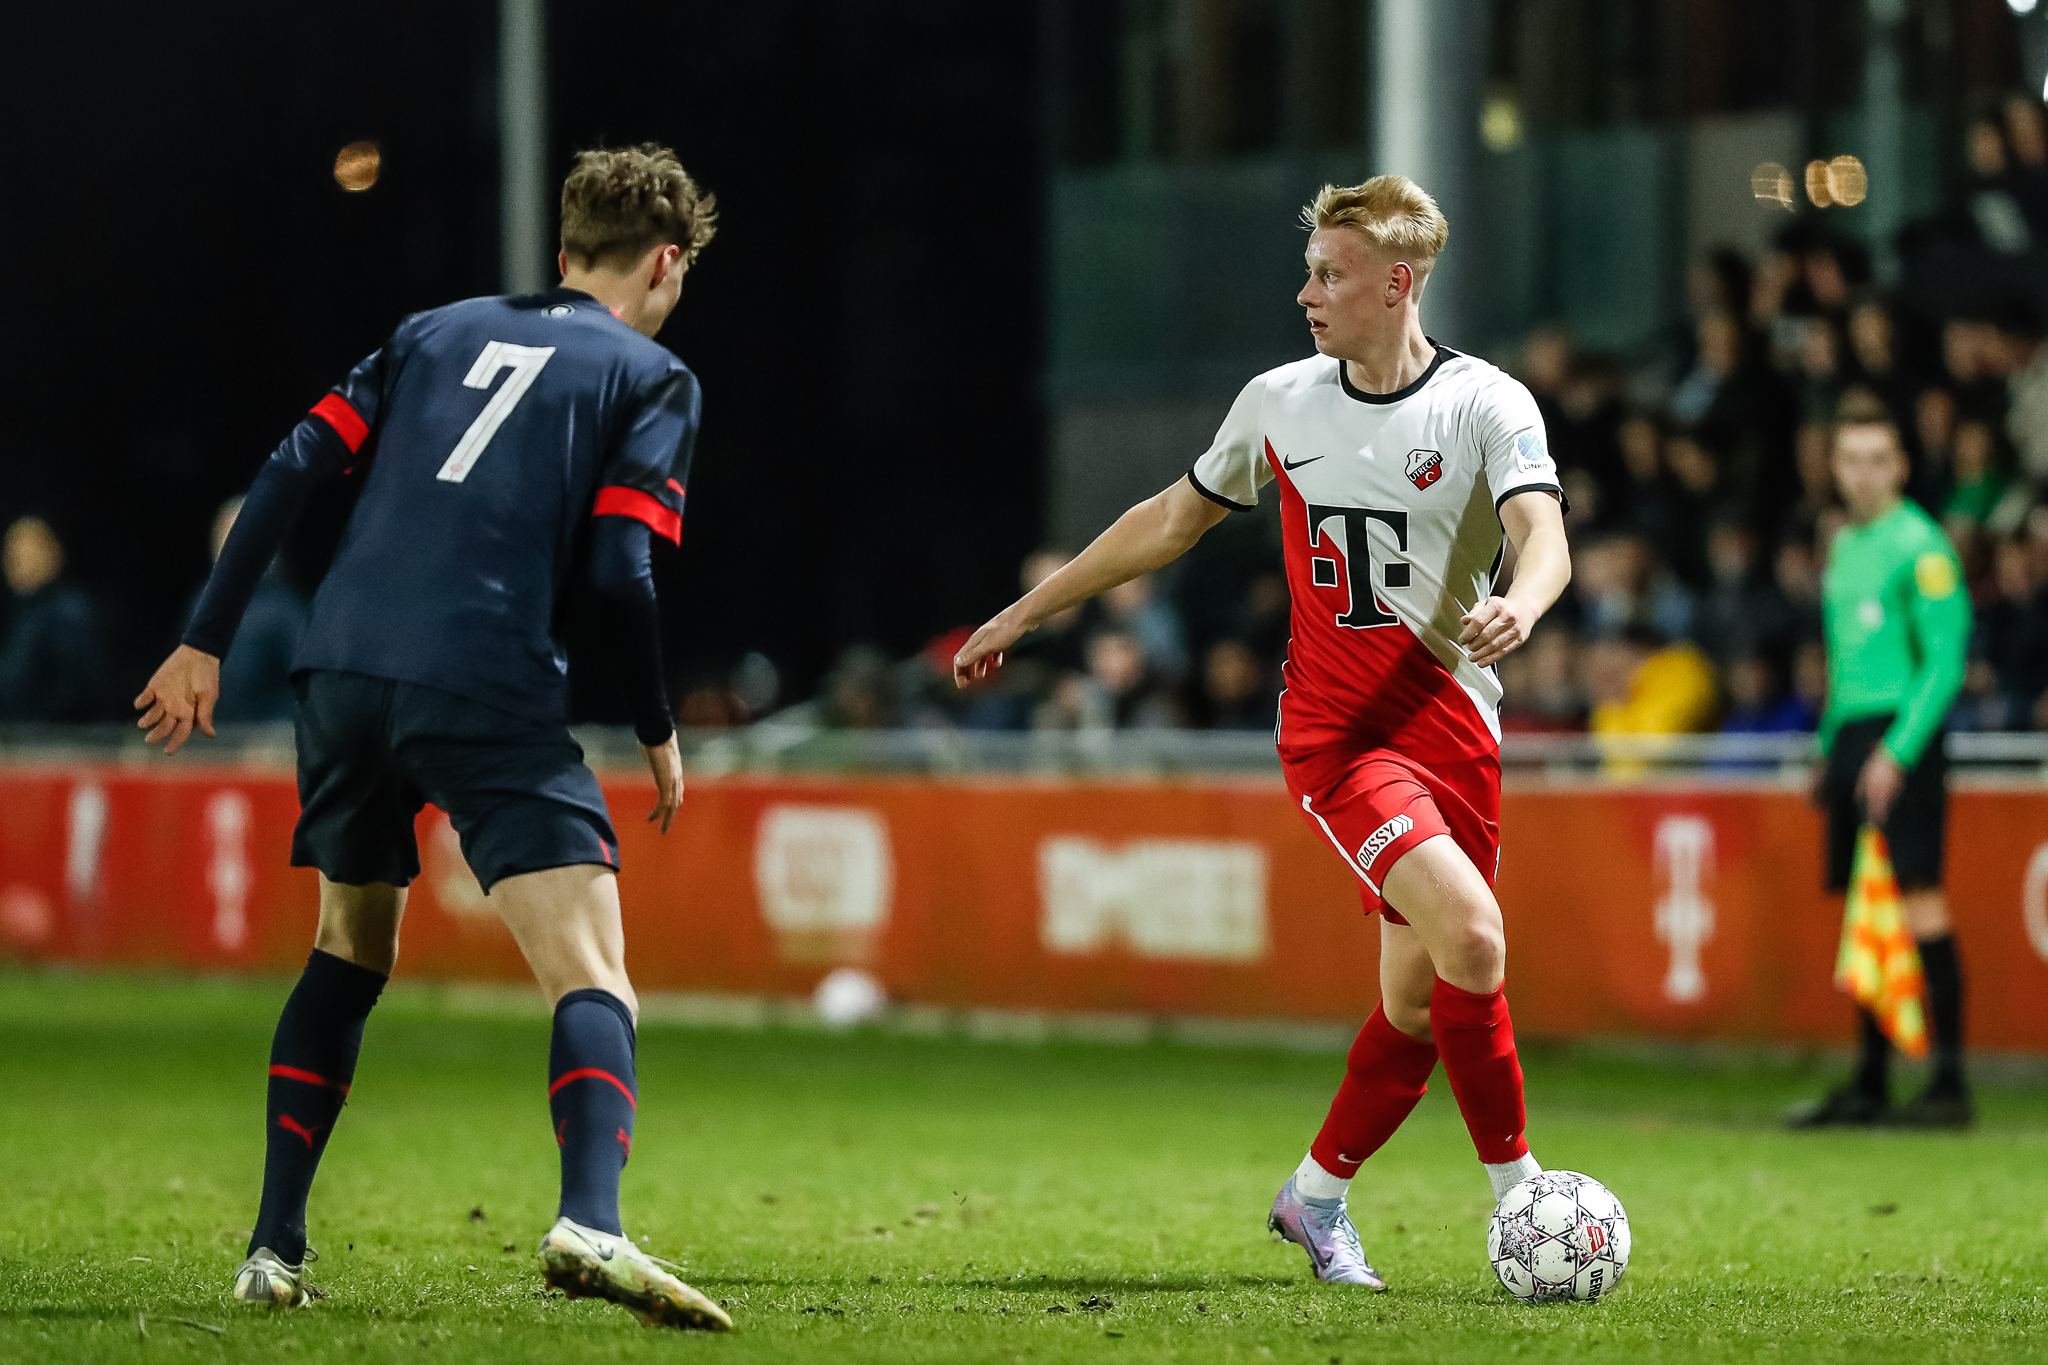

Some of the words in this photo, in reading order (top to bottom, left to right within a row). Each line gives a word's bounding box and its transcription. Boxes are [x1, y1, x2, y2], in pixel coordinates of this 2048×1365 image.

[436, 340, 556, 483] 7
[1409, 453, 1441, 482] UTRECHT
[1414, 453, 1421, 463] F
[1424, 471, 1434, 482] C
[1358, 822, 1396, 867] DASSY
